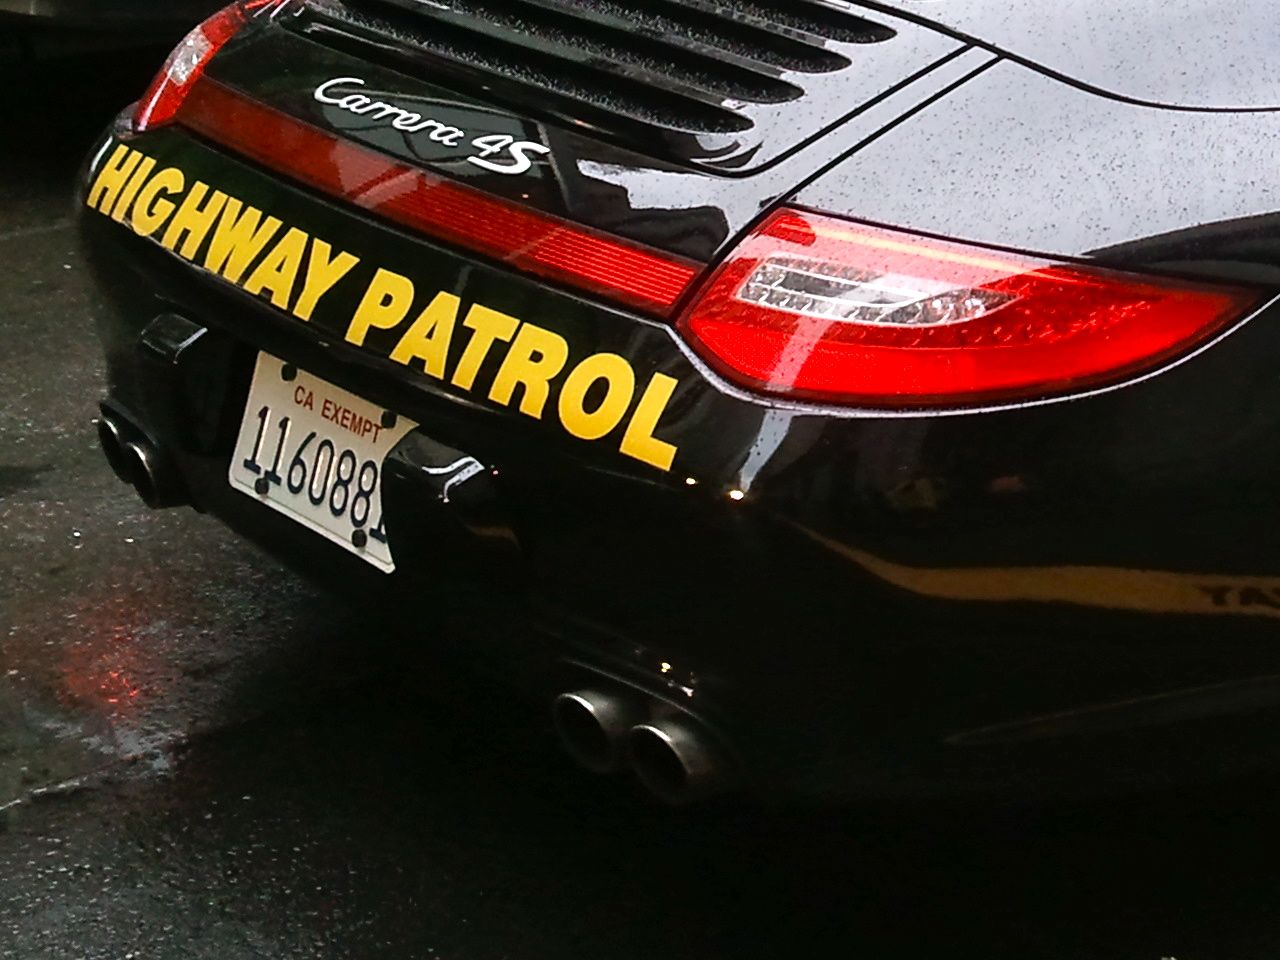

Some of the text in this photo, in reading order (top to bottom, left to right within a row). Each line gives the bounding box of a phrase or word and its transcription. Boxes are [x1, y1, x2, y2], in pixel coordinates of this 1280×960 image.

[313, 76, 551, 176] Carrera 4S
[85, 145, 680, 472] HIGHWAY PATROL
[294, 385, 384, 444] CA EXEMPT
[243, 405, 388, 545] 116088
